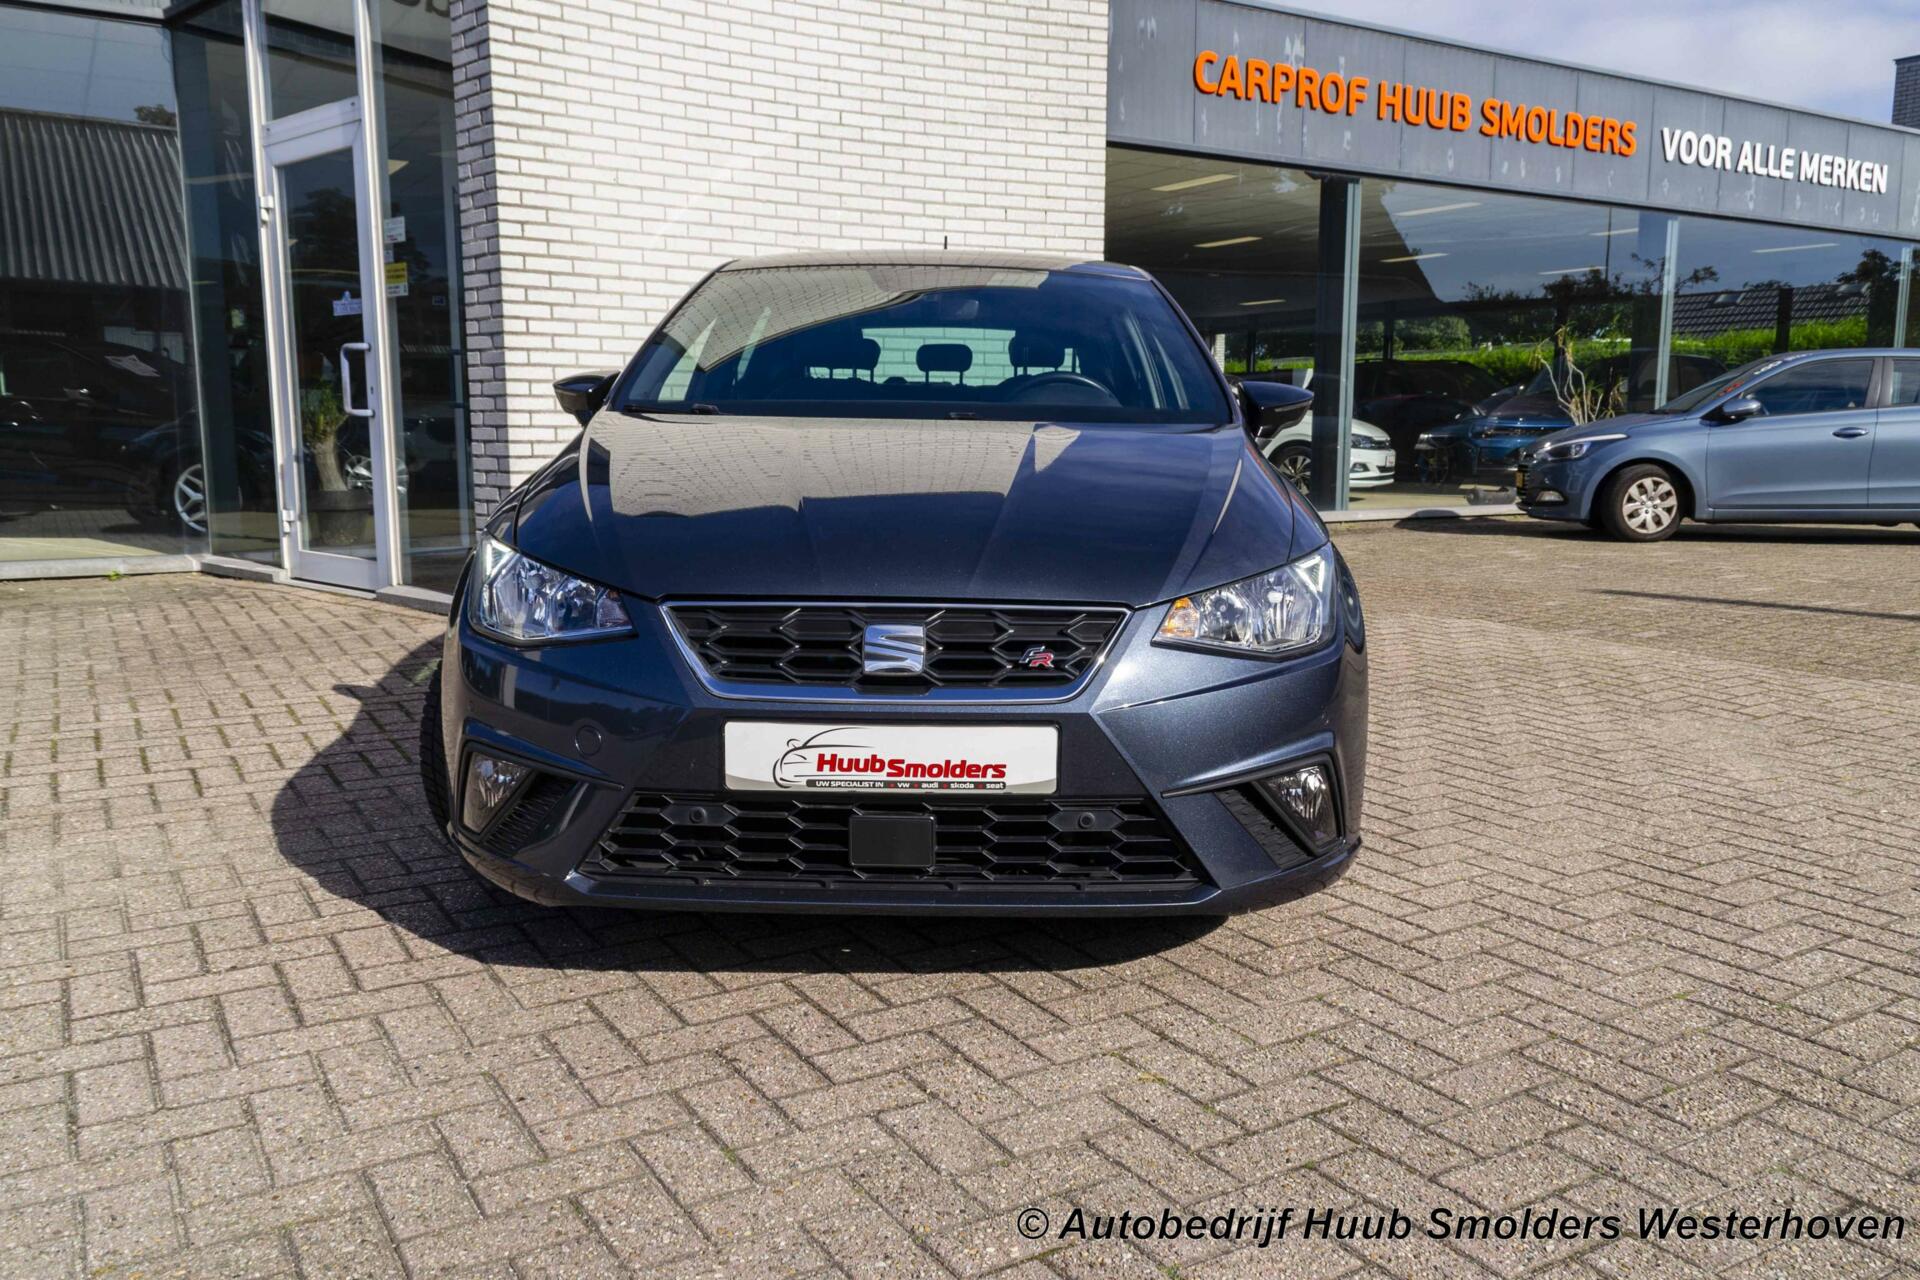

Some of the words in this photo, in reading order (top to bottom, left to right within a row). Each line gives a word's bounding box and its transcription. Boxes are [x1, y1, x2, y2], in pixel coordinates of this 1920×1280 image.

[1194, 50, 1369, 116] CARPROF
[1378, 80, 1471, 132] HUUB
[1480, 98, 1637, 158] SMOLDERS
[1662, 126, 1733, 170] VOOR
[1737, 139, 1795, 180] ALLE
[1799, 149, 1889, 194] MERKEN
[830, 780, 874, 788] SPECIALIST
[921, 781, 939, 789] audi
[950, 782, 975, 790] skoda
[985, 782, 1004, 790] seat
